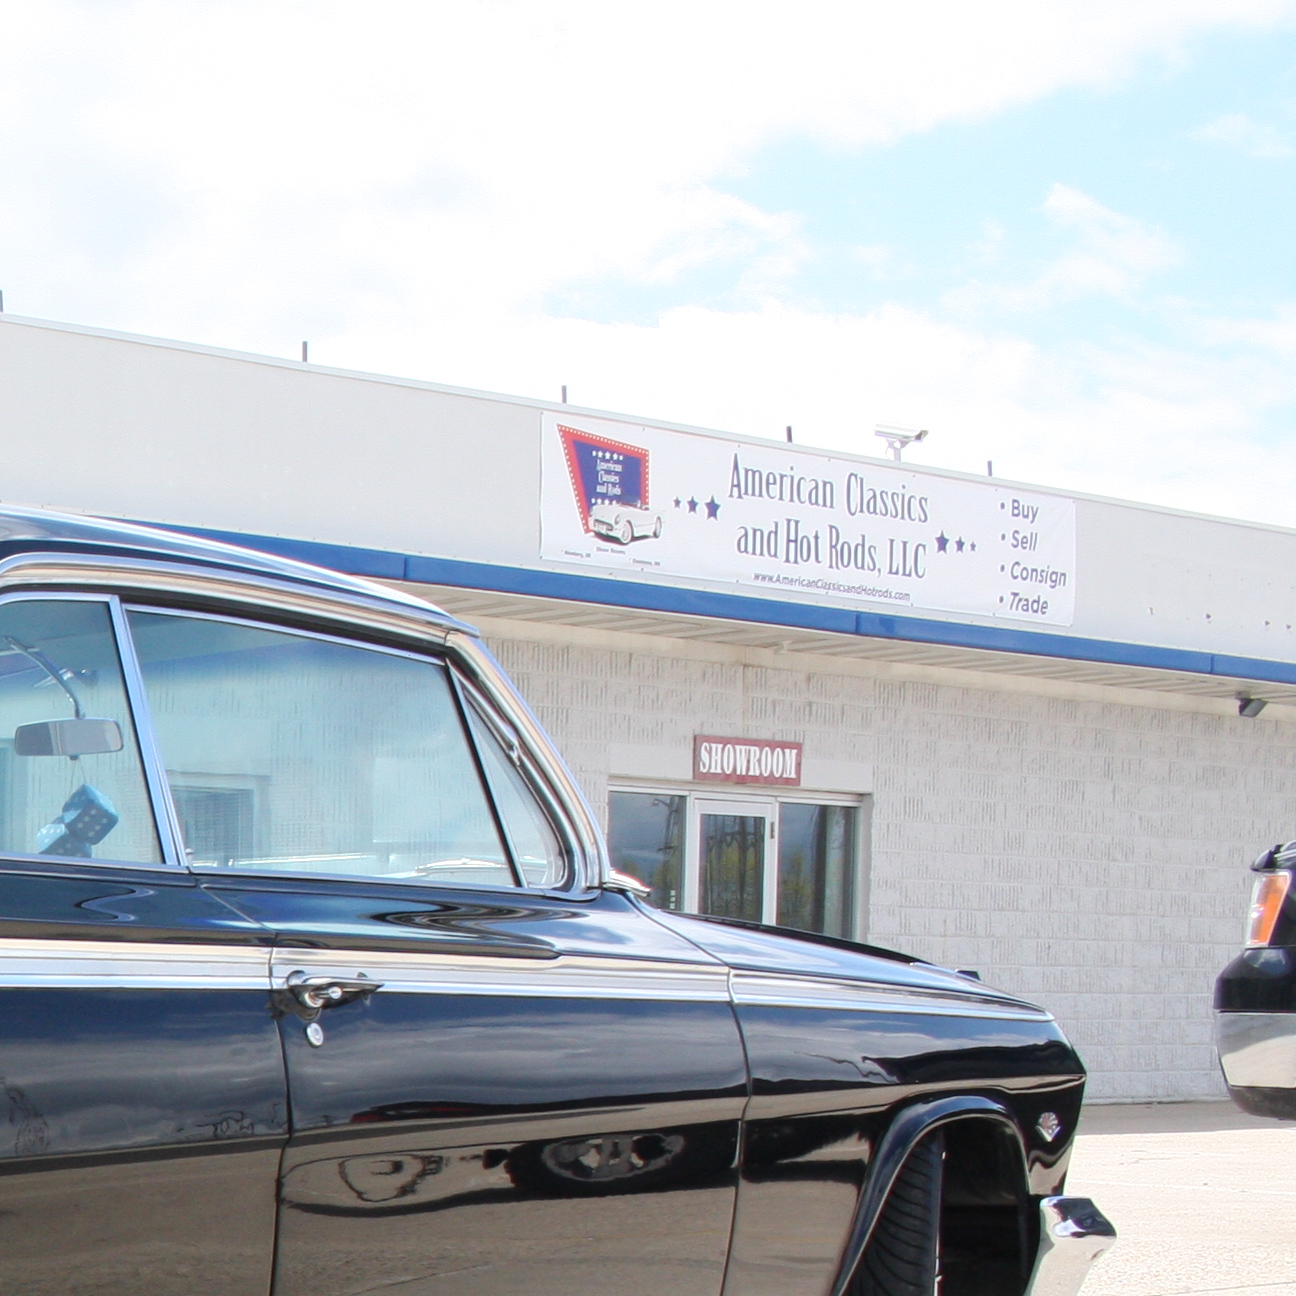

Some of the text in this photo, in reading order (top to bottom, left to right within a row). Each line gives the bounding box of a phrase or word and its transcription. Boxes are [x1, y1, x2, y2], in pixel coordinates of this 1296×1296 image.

[728, 453, 928, 523] American Classics
[1011, 499, 1039, 524] Buy
[736, 518, 927, 579] and Hot Rods, LLC
[1010, 529, 1039, 551] Sell
[1010, 561, 1067, 589] Consign
[1009, 591, 1049, 615] Trade
[699, 742, 797, 779] SHOWROOM
